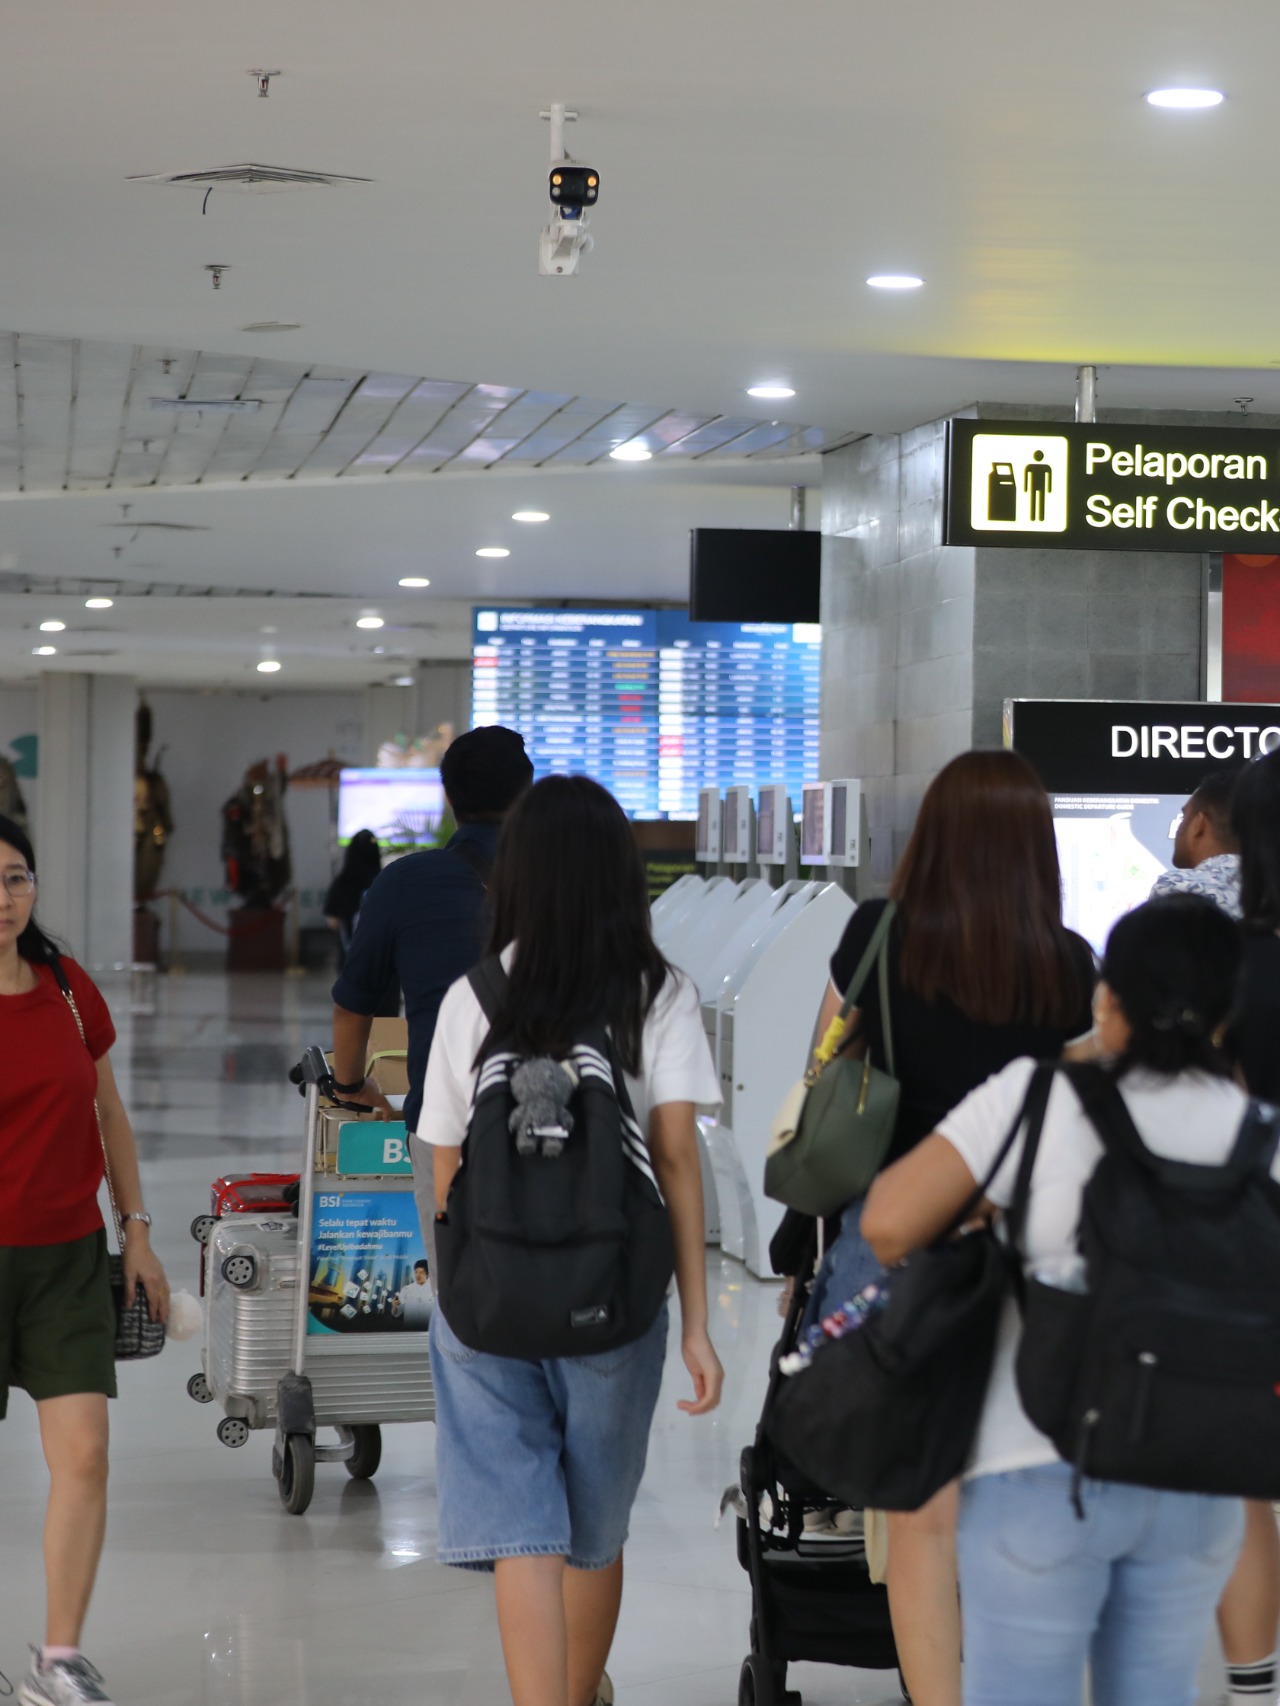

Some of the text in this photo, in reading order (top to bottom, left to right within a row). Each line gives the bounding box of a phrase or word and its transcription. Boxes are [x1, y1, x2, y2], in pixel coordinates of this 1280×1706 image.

[1085, 442, 1267, 485] Pelaporan
[1085, 494, 1159, 529] Self
[319, 1195, 341, 1207] BSI
[318, 1218, 397, 1228] Selalu tepat waktu
[318, 1229, 413, 1239] Jalankan kewajibanmu
